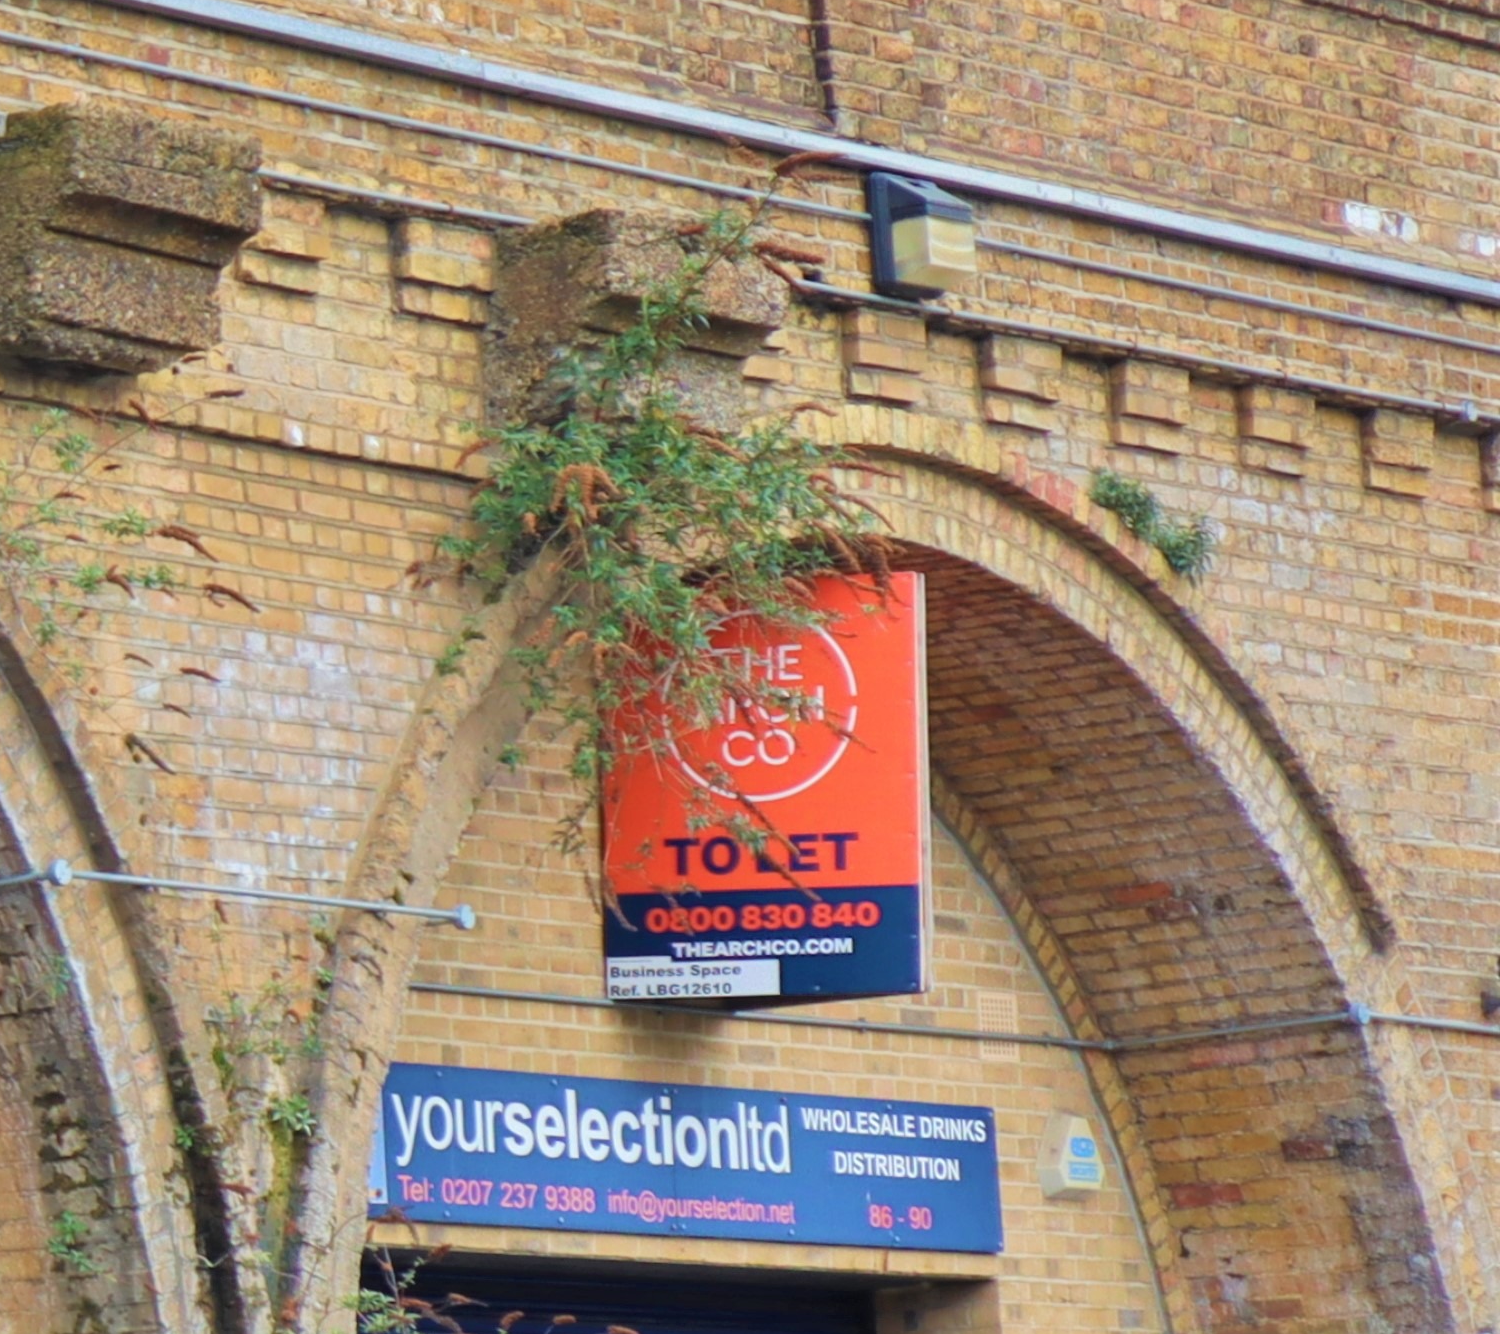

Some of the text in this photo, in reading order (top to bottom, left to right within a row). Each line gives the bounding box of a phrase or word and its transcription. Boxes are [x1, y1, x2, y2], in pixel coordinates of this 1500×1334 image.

[721, 729, 796, 766] CO
[664, 836, 740, 876] TO
[646, 901, 880, 933] 0800 830 840
[672, 937, 854, 958] THEARCHCO.COM
[610, 964, 742, 979] Business Space
[610, 982, 732, 997] Ref. LBG12610
[391, 1089, 791, 1174] yourselectionltd
[801, 1107, 986, 1144] WHOLESALE DRINKS
[834, 1150, 960, 1182] DISTRIBUTION
[397, 1174, 796, 1225] Tel: 0207 237 9388 info@yourselection.net
[869, 1204, 893, 1230] 86
[908, 1205, 932, 1231] 90
